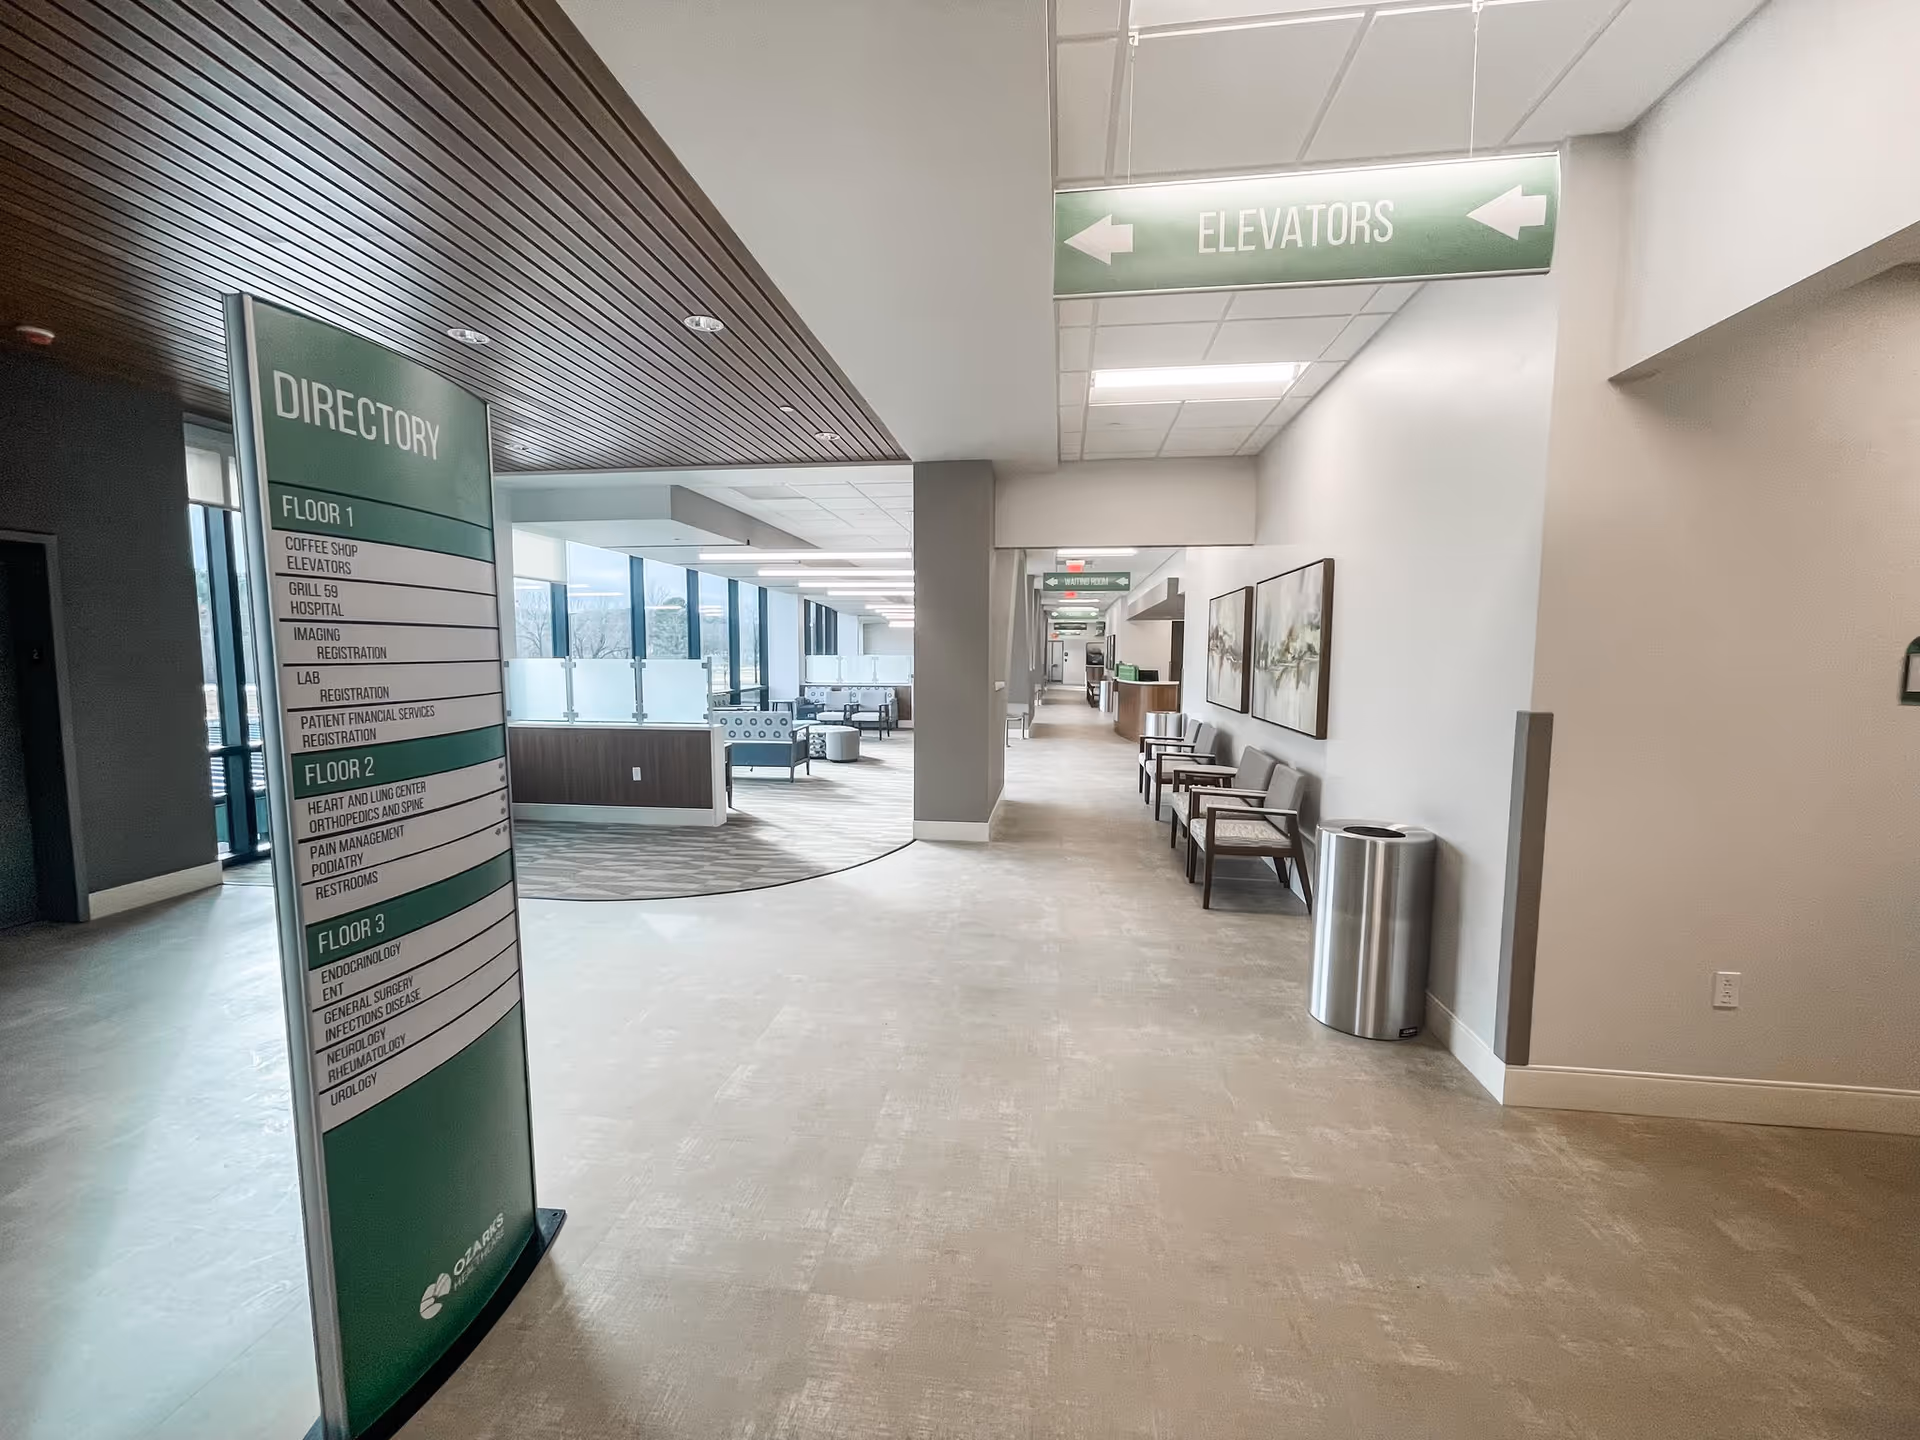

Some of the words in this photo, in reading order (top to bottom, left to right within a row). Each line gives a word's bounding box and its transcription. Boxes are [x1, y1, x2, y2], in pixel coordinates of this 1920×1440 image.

[1198, 200, 1395, 254] ELEVATORS
[273, 370, 440, 460] DIRECTORY
[282, 495, 340, 525] FLOOR
[346, 506, 354, 527] 1
[285, 536, 329, 557] COFFEE
[331, 542, 358, 557] SHOP
[287, 556, 352, 575] ELEVATORS
[289, 581, 322, 597] GRILL
[324, 584, 338, 598] 59
[1090, 577, 1109, 586] ROOM
[291, 601, 345, 617] HOSPITAL
[294, 627, 341, 642] IMAGING
[317, 646, 387, 660] REGISTRATION
[297, 671, 321, 685] LAB
[320, 686, 390, 702] REGISTRATION
[301, 713, 346, 730] PATIENT
[349, 708, 397, 725] FINANCIAL
[399, 705, 436, 720] SERVICES
[303, 728, 377, 748] REGISTRATION
[305, 759, 361, 786] FLOOR
[364, 757, 375, 777] 2
[308, 796, 345, 815] HEART
[348, 790, 368, 808] AND
[370, 786, 394, 804] LUNG
[396, 781, 427, 799] CENTER
[309, 807, 380, 833] ORTHOPEDICS
[382, 803, 400, 819] AND
[401, 797, 425, 814] SPINE
[310, 845, 337, 860] PAIN
[339, 825, 405, 853] MANAGEMENT
[311, 853, 364, 878] PODIATRY
[315, 871, 379, 900] RESTROOMS
[318, 918, 371, 954] FLOOR
[375, 914, 385, 934] 3
[321, 942, 402, 984] ENDOCRINOLOGY
[322, 982, 344, 1002] ENT
[324, 996, 373, 1025] GENERAL
[374, 976, 414, 1004] SURGERY
[386, 988, 422, 1017] DISEASE
[327, 1027, 387, 1066] NEUROLOGY
[328, 1033, 407, 1083] RHEUMATOLOGY
[331, 1072, 378, 1106] UROLOGY
[454, 1213, 503, 1275] OZARKS
